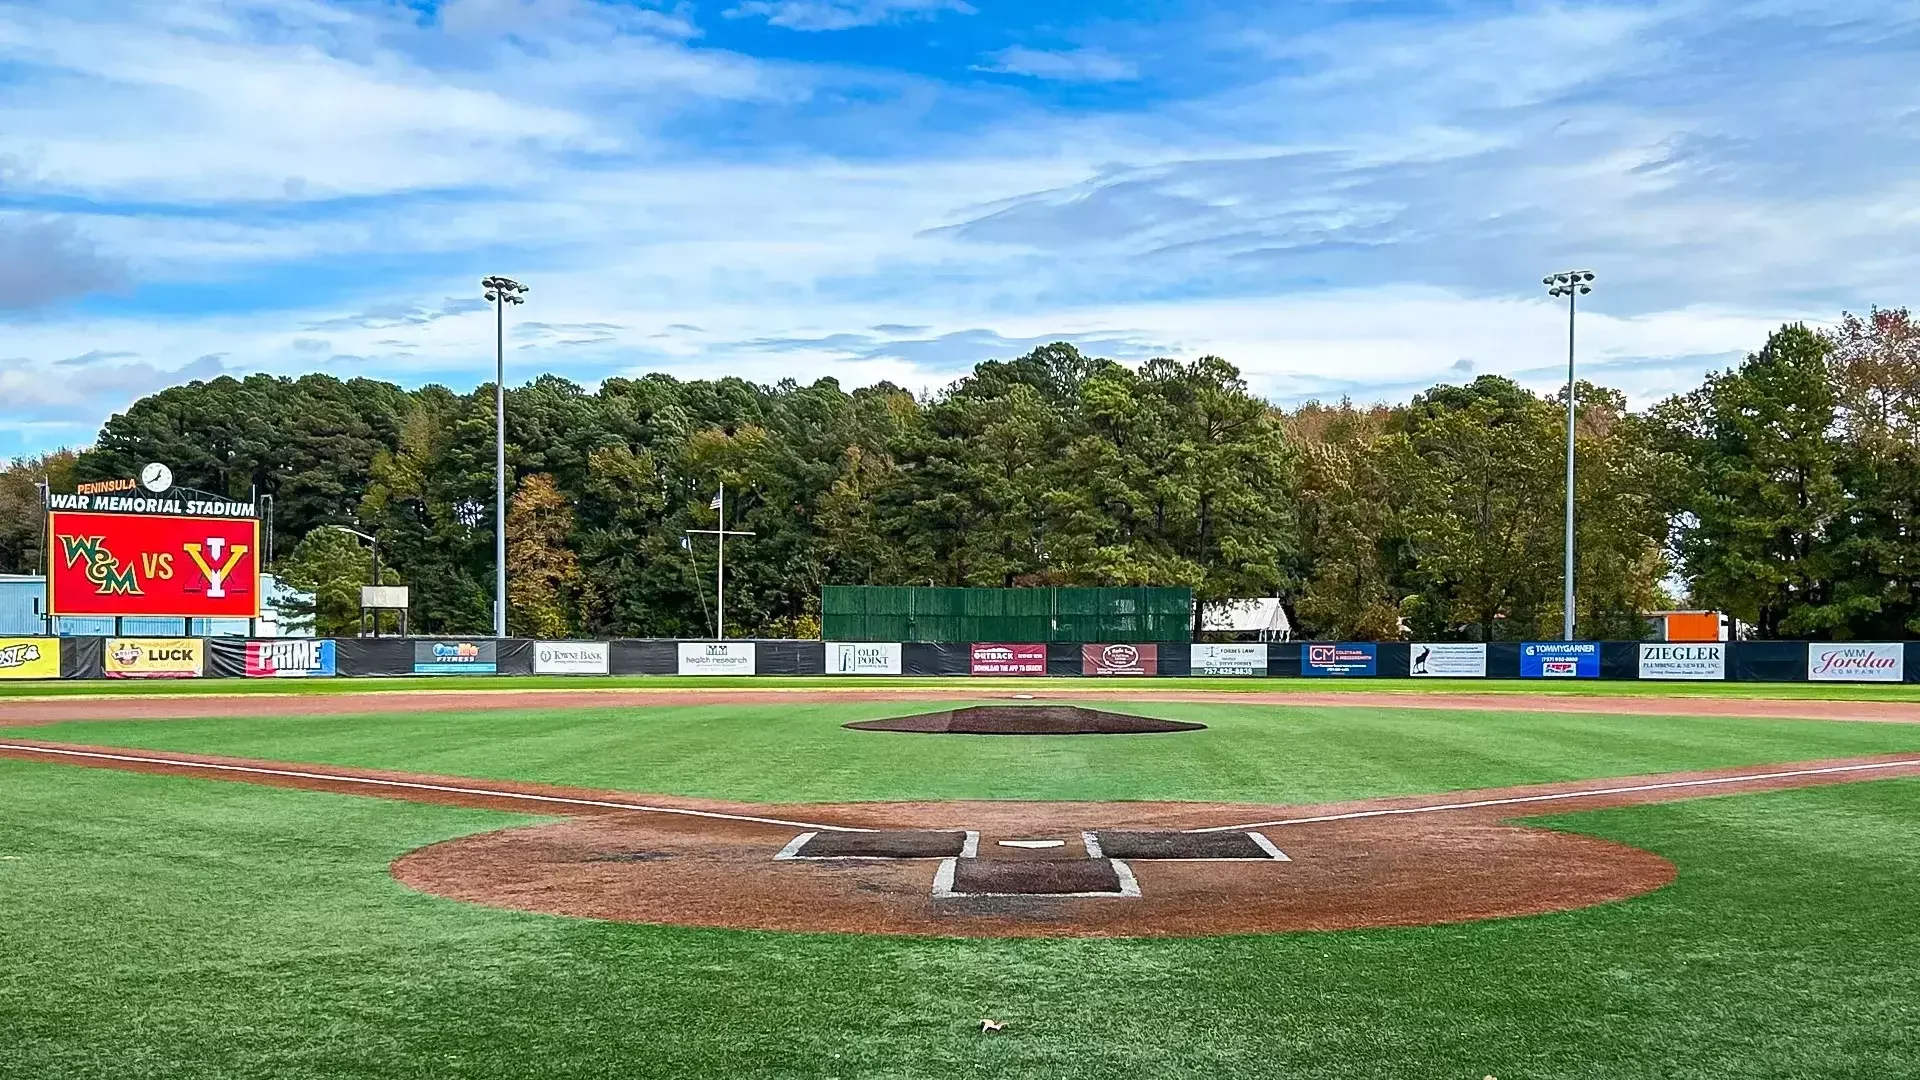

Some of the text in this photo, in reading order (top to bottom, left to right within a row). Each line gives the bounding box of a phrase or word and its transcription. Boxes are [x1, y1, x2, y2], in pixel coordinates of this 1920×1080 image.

[77, 478, 137, 495] PENINSULA
[50, 494, 255, 517] WAR MEMORIAL STADIUM
[142, 552, 174, 580] VS
[148, 649, 194, 661] LUCK
[257, 641, 322, 670] PRIME
[858, 648, 879, 657] OLD
[973, 652, 1014, 660] OUTBACK
[1312, 648, 1334, 661] CM
[1643, 647, 1720, 660] ZIEGLER
[686, 656, 748, 664] health research
[858, 656, 889, 665] POINT
[1812, 650, 1895, 674] Jordan
